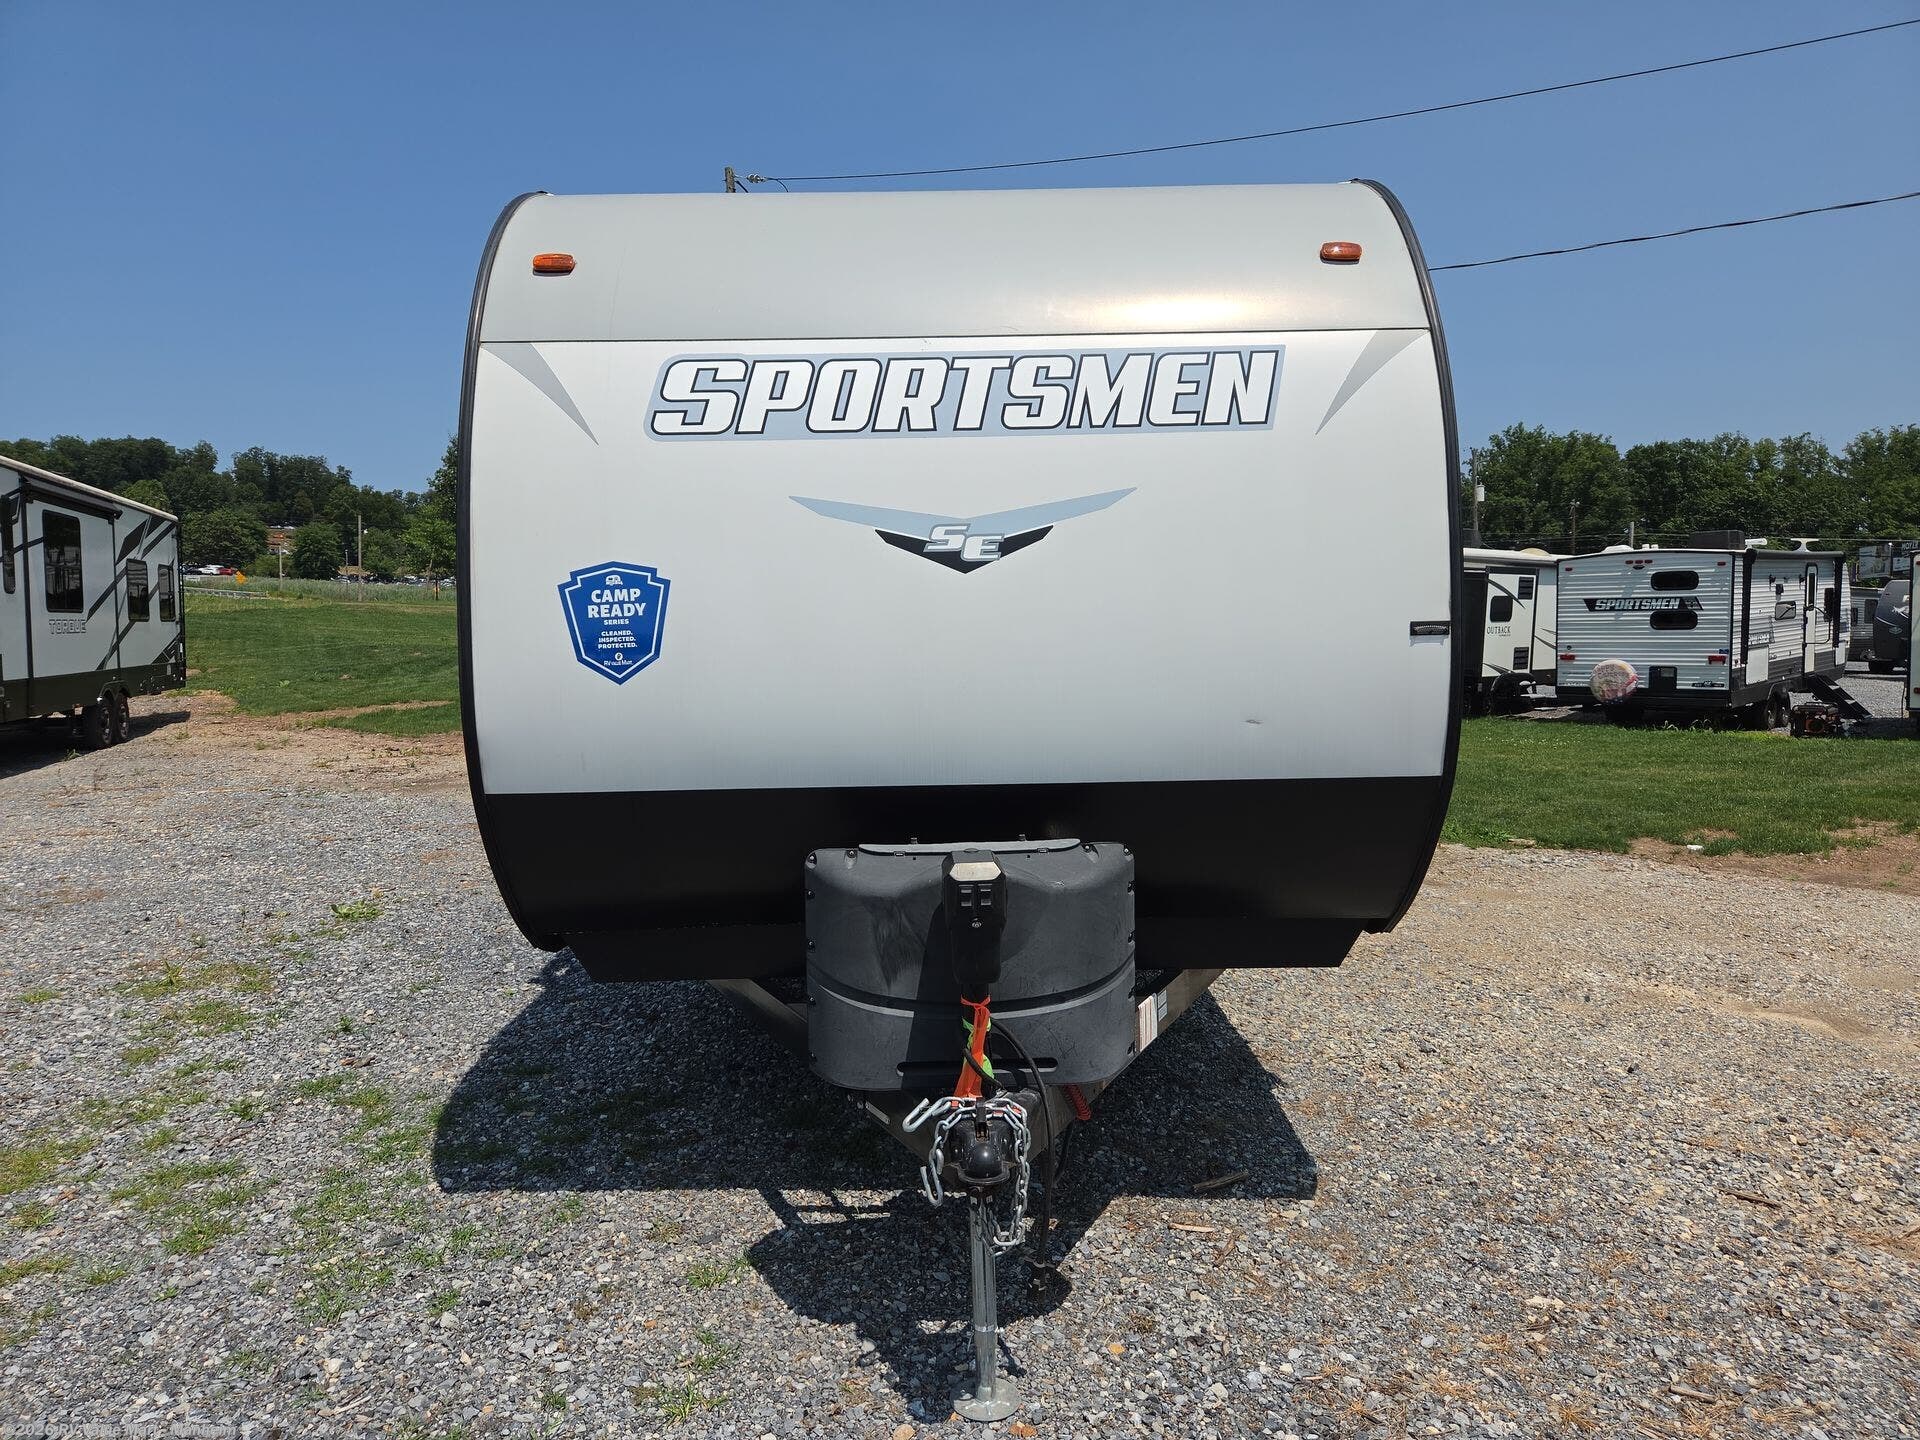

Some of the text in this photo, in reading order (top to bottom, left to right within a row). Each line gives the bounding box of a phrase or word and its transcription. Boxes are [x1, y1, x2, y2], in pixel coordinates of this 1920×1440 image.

[651, 349, 1280, 435] SPORTSMEN
[924, 523, 1005, 562] SE
[591, 588, 641, 603] CAMP
[587, 602, 647, 618] READY
[1594, 598, 1680, 611] SPORTSMEN
[49, 619, 87, 634] TORQUE
[603, 618, 630, 626] SERIES
